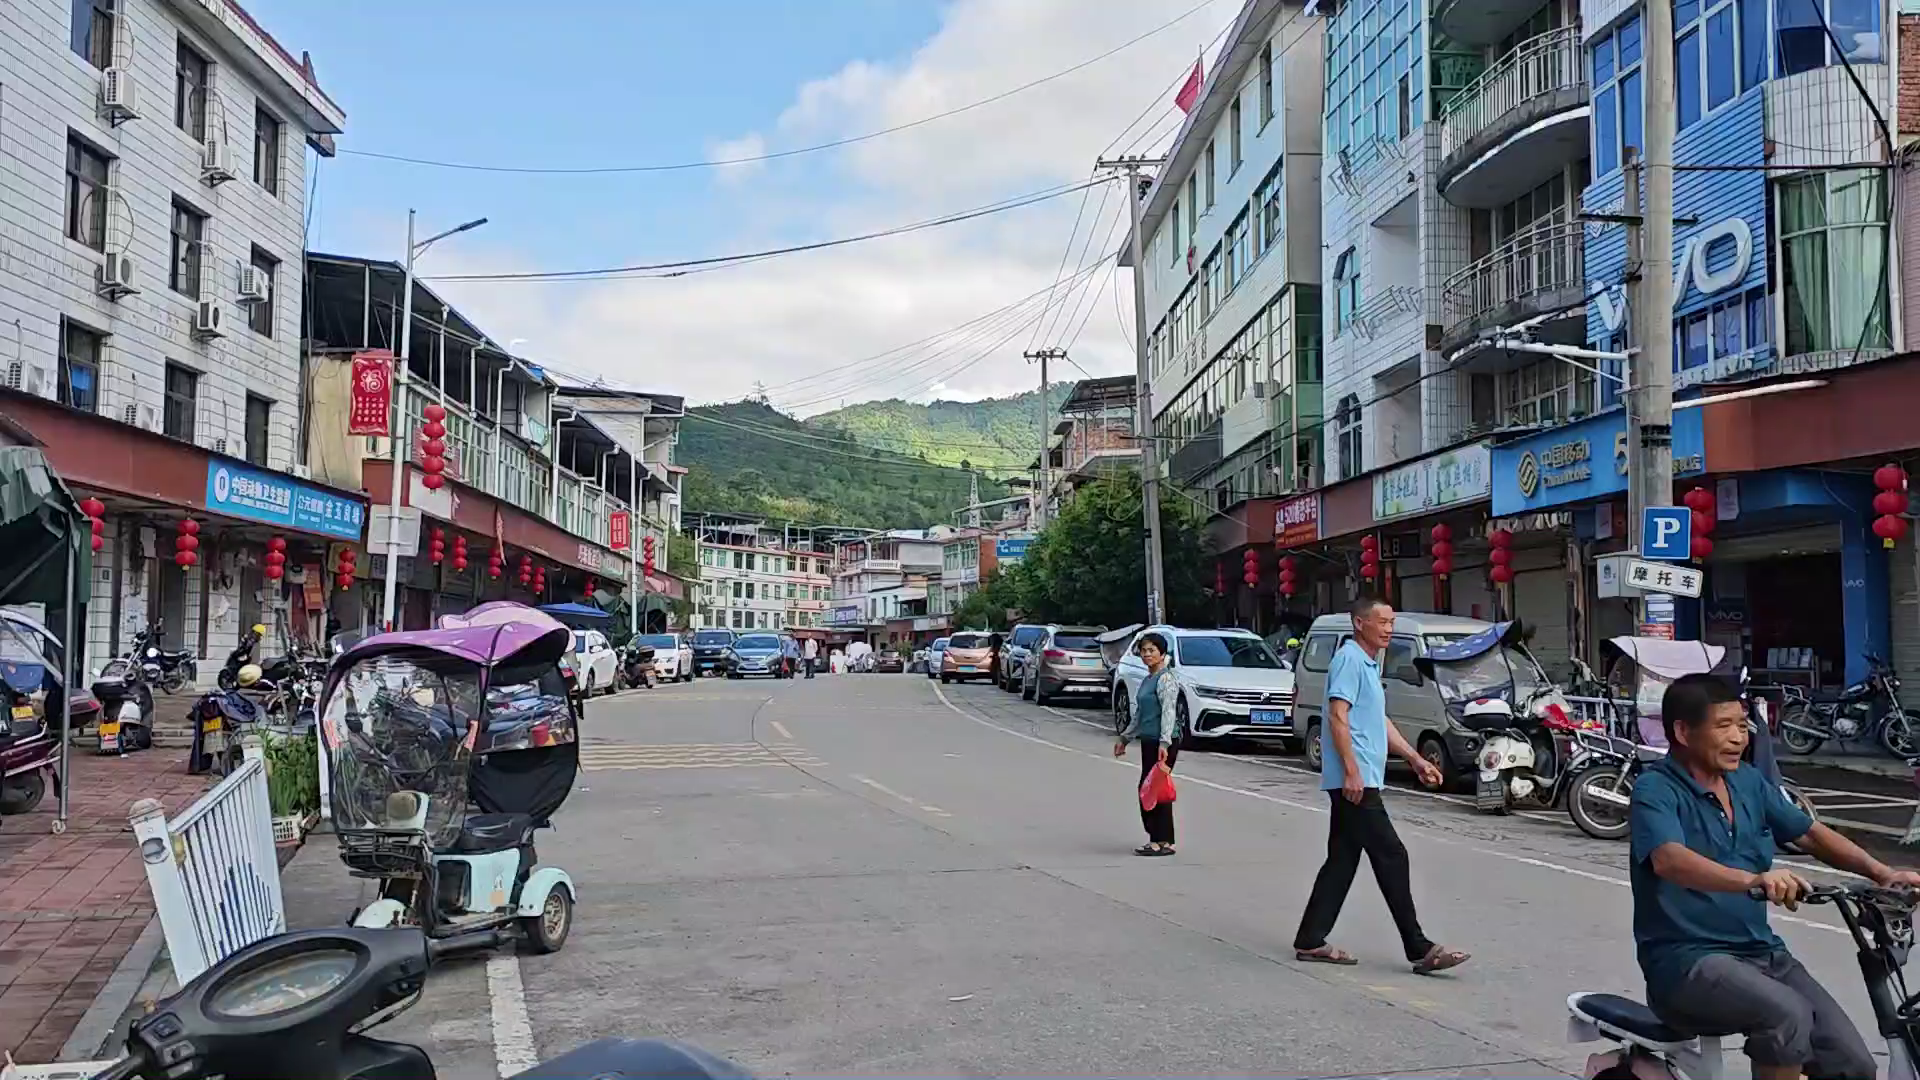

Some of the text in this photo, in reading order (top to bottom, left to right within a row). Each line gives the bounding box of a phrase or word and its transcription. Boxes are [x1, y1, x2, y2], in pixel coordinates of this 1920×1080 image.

[1590, 217, 1753, 331] vo
[1541, 440, 1591, 468] 中国移动
[1652, 517, 1681, 549] P
[1633, 566, 1696, 590] 摩托车
